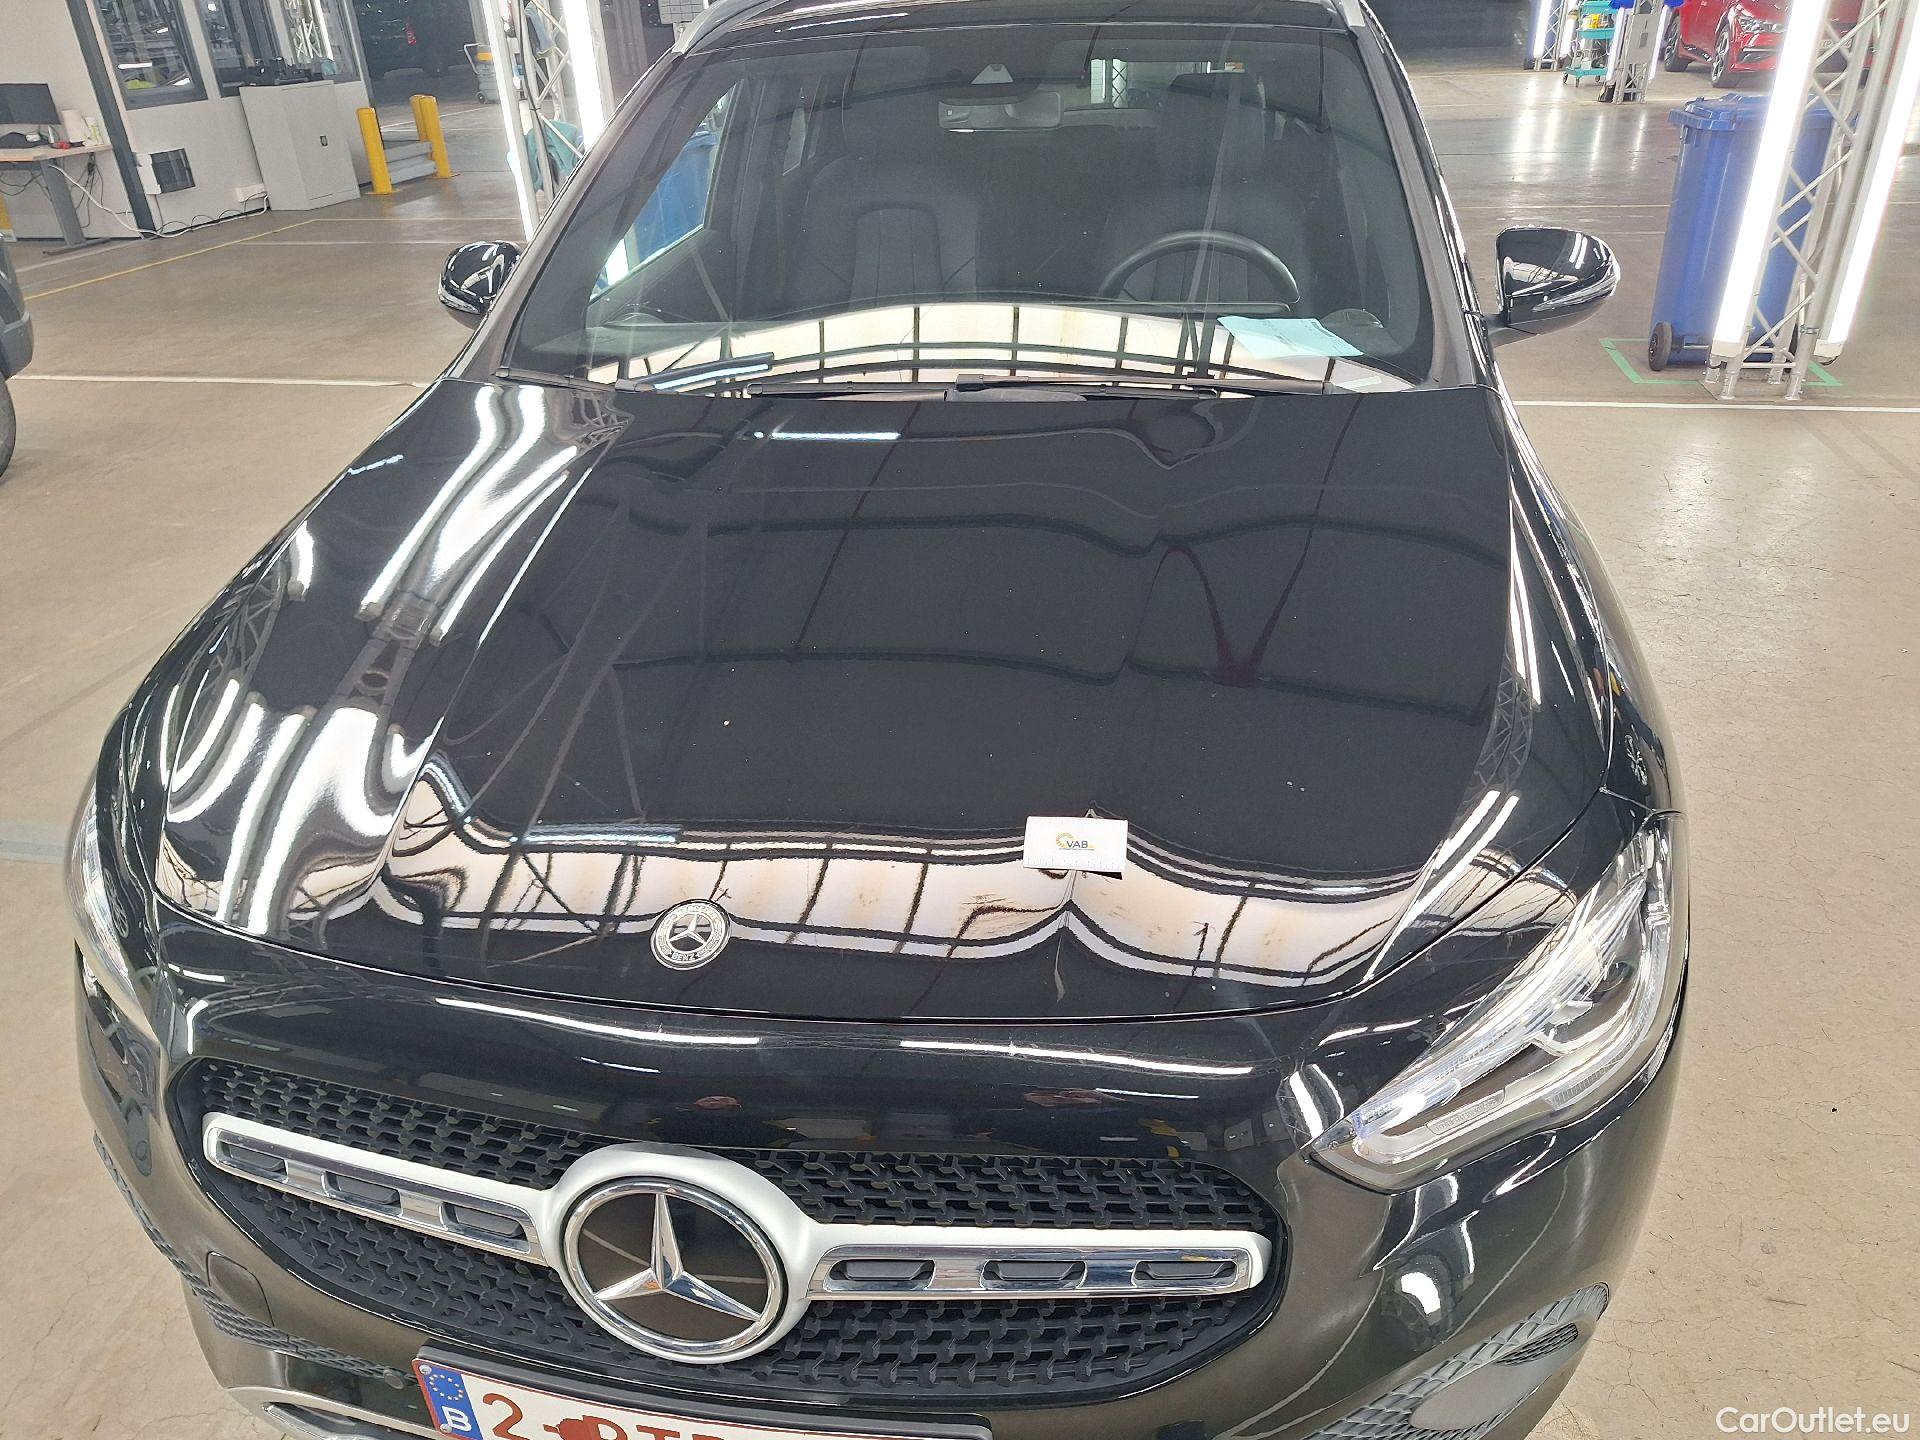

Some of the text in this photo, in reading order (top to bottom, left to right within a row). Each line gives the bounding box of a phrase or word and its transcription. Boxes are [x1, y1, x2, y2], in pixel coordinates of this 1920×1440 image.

[1066, 840, 1088, 848] VAB
[671, 952, 696, 961] BENZ
[442, 1405, 472, 1432] B
